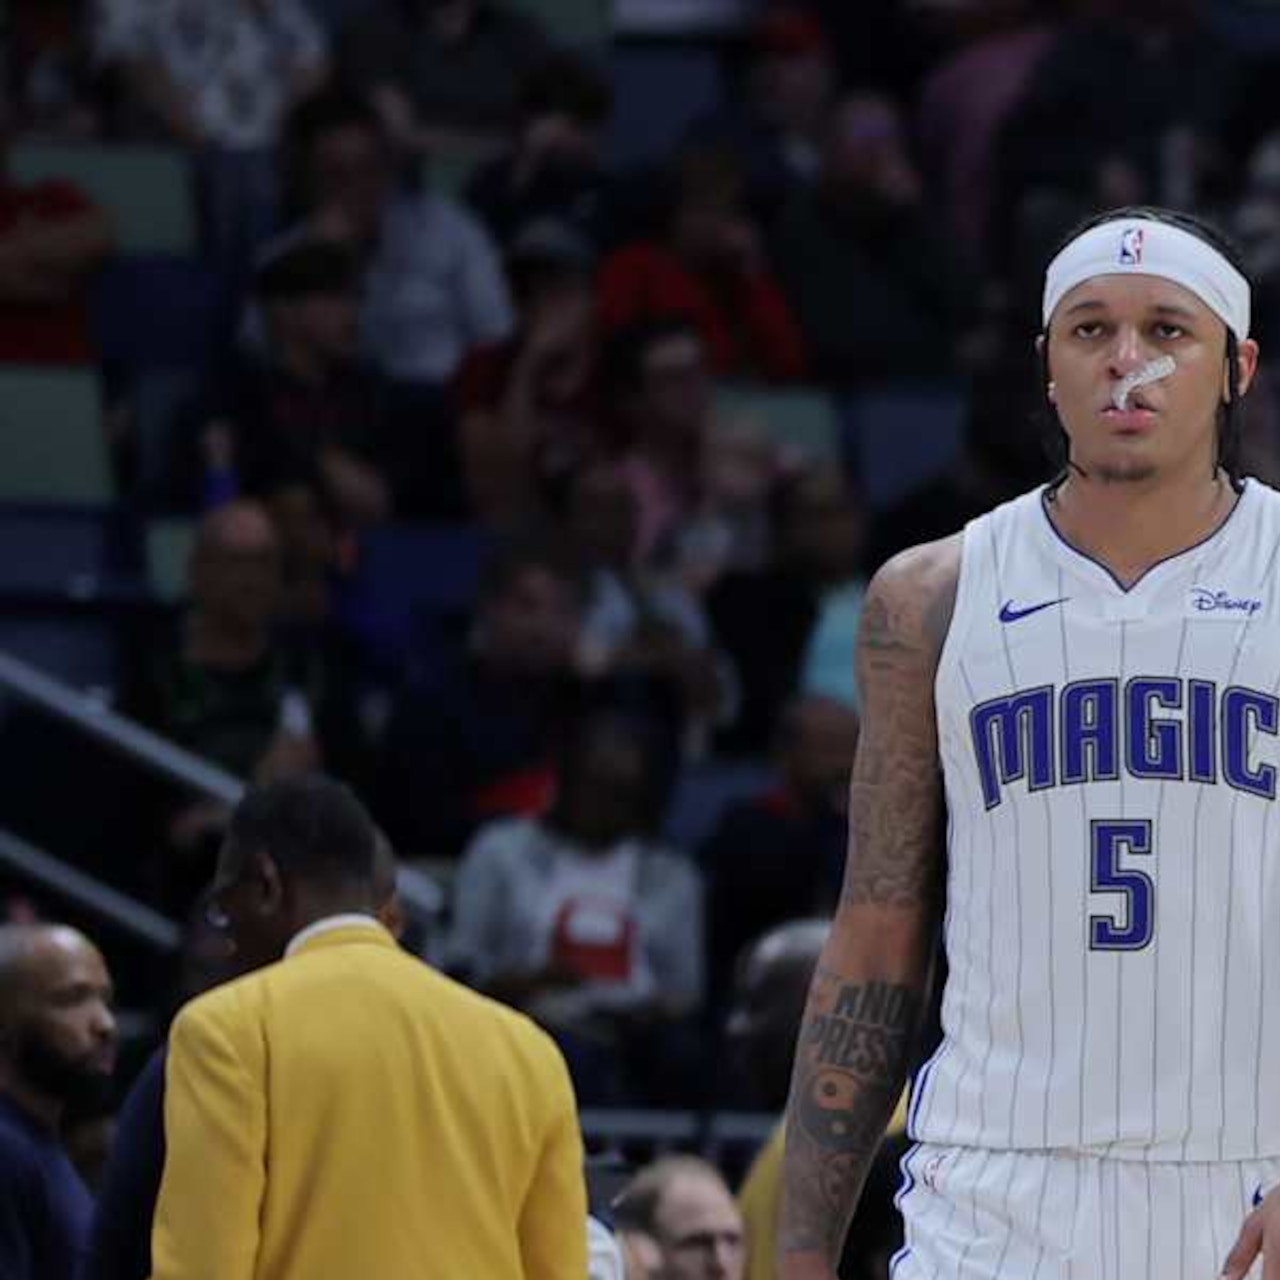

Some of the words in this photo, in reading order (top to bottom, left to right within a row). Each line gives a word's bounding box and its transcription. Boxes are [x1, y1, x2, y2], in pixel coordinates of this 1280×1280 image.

[1190, 588, 1262, 616] Disney
[969, 676, 1280, 811] MAGIC
[1090, 819, 1153, 950] 5
